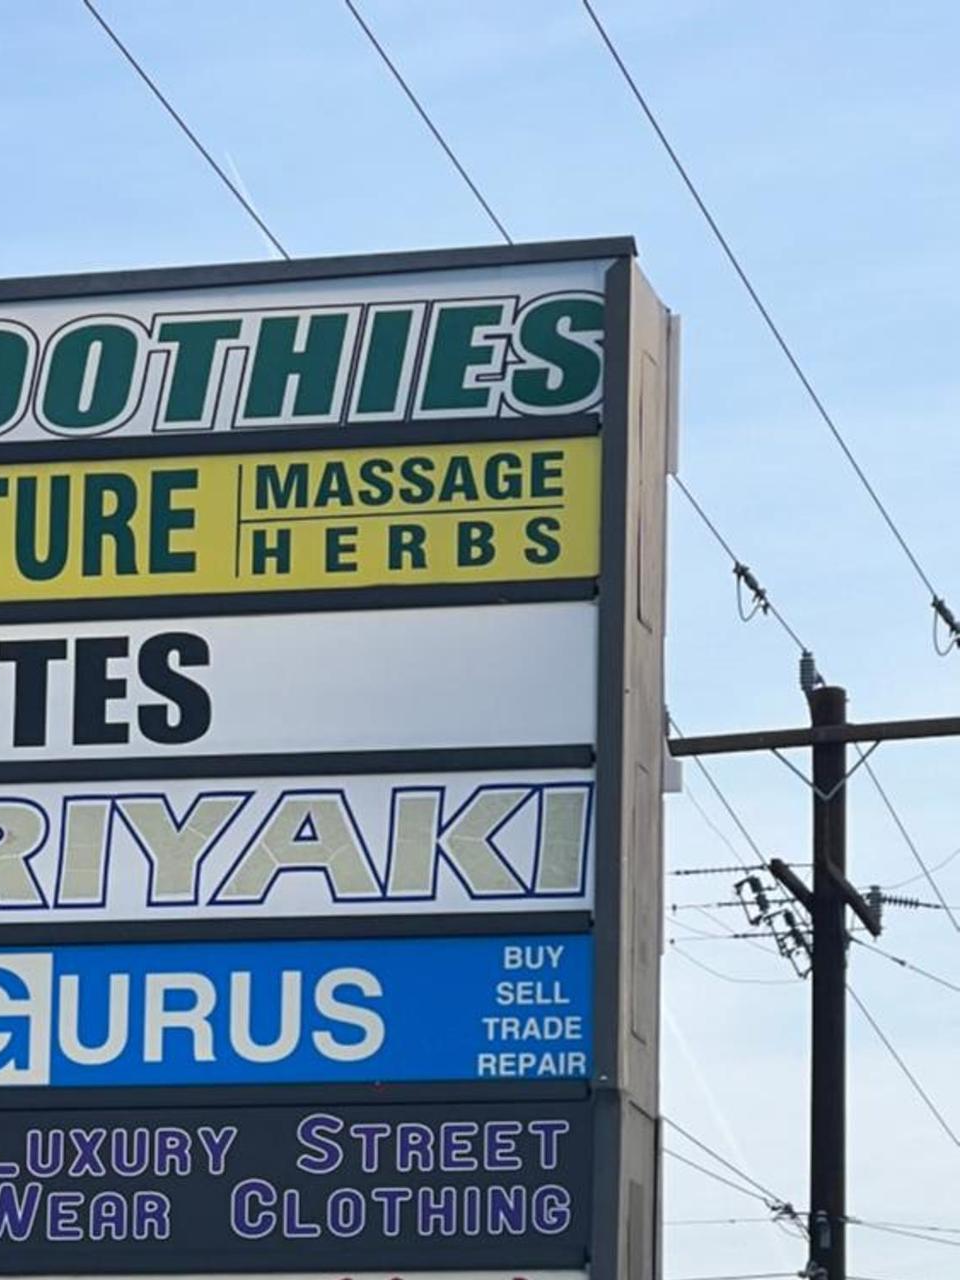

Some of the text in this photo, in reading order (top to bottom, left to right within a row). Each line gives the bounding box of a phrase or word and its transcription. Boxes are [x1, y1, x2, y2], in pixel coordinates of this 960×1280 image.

[255, 451, 564, 510] MASSAGE
[251, 517, 561, 576] HERBS
[503, 946, 564, 969] BUY
[496, 981, 570, 1005] SELL
[483, 1017, 582, 1041] TRADE
[477, 1053, 587, 1077] REPAIR
[296, 1112, 570, 1175] STREET
[230, 1179, 571, 1239] CLOTHING
